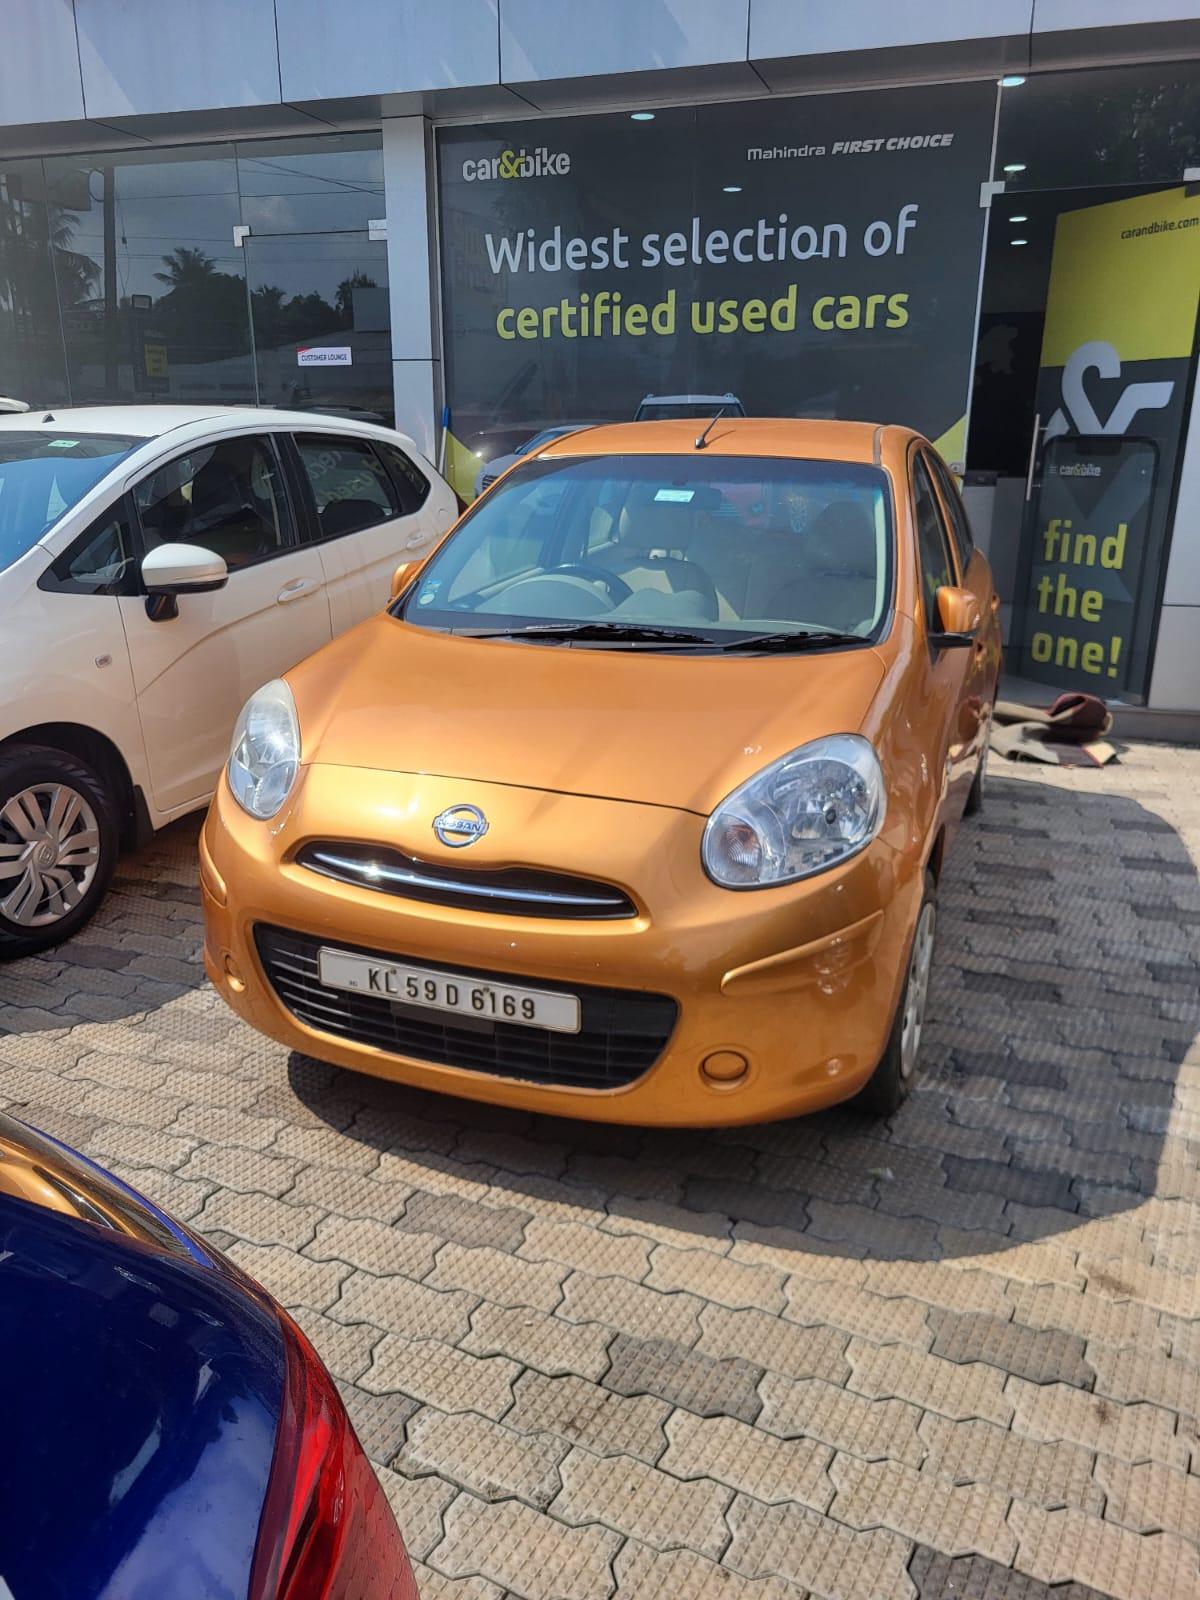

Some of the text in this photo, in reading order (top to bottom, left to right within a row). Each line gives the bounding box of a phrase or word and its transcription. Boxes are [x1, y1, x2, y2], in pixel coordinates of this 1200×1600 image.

[462, 147, 571, 182] car&bike
[747, 133, 954, 161] Mahindra FIRST CHOICE
[484, 203, 919, 274] Widest selection of
[1120, 217, 1200, 240] carandbike.com
[496, 284, 910, 340] certified used cars
[1043, 519, 1128, 570] find
[1037, 573, 1104, 623] the
[1031, 631, 1122, 679] one!
[437, 818, 481, 832] NSSAN
[368, 968, 536, 1020] KL 59 D 6169
